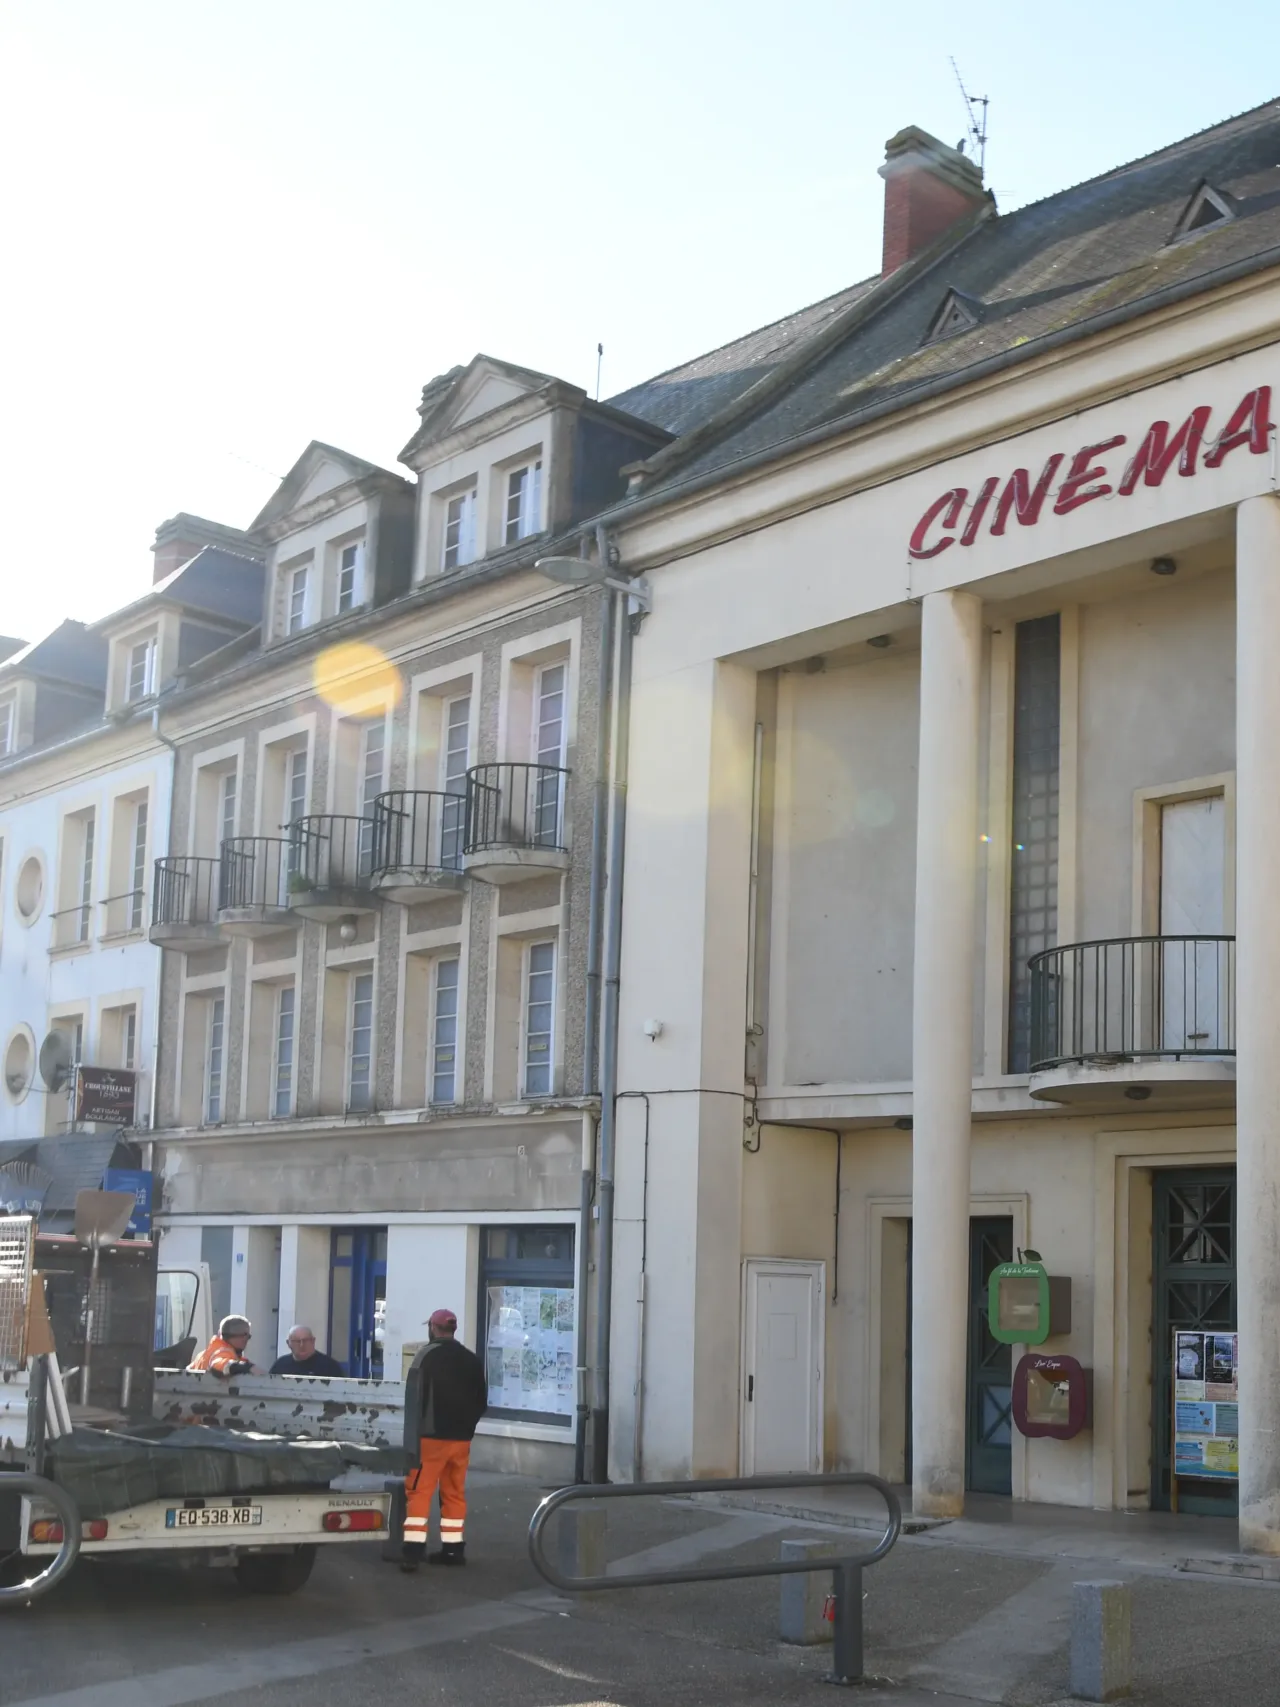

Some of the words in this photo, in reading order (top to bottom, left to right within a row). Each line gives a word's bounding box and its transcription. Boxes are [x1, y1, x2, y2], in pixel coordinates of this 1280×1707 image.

[908, 385, 1277, 559] CINEMA
[92, 1107, 121, 1115] ARTISAN
[85, 1113, 127, 1122] BOULANGER
[328, 1499, 376, 1507] RENAULT
